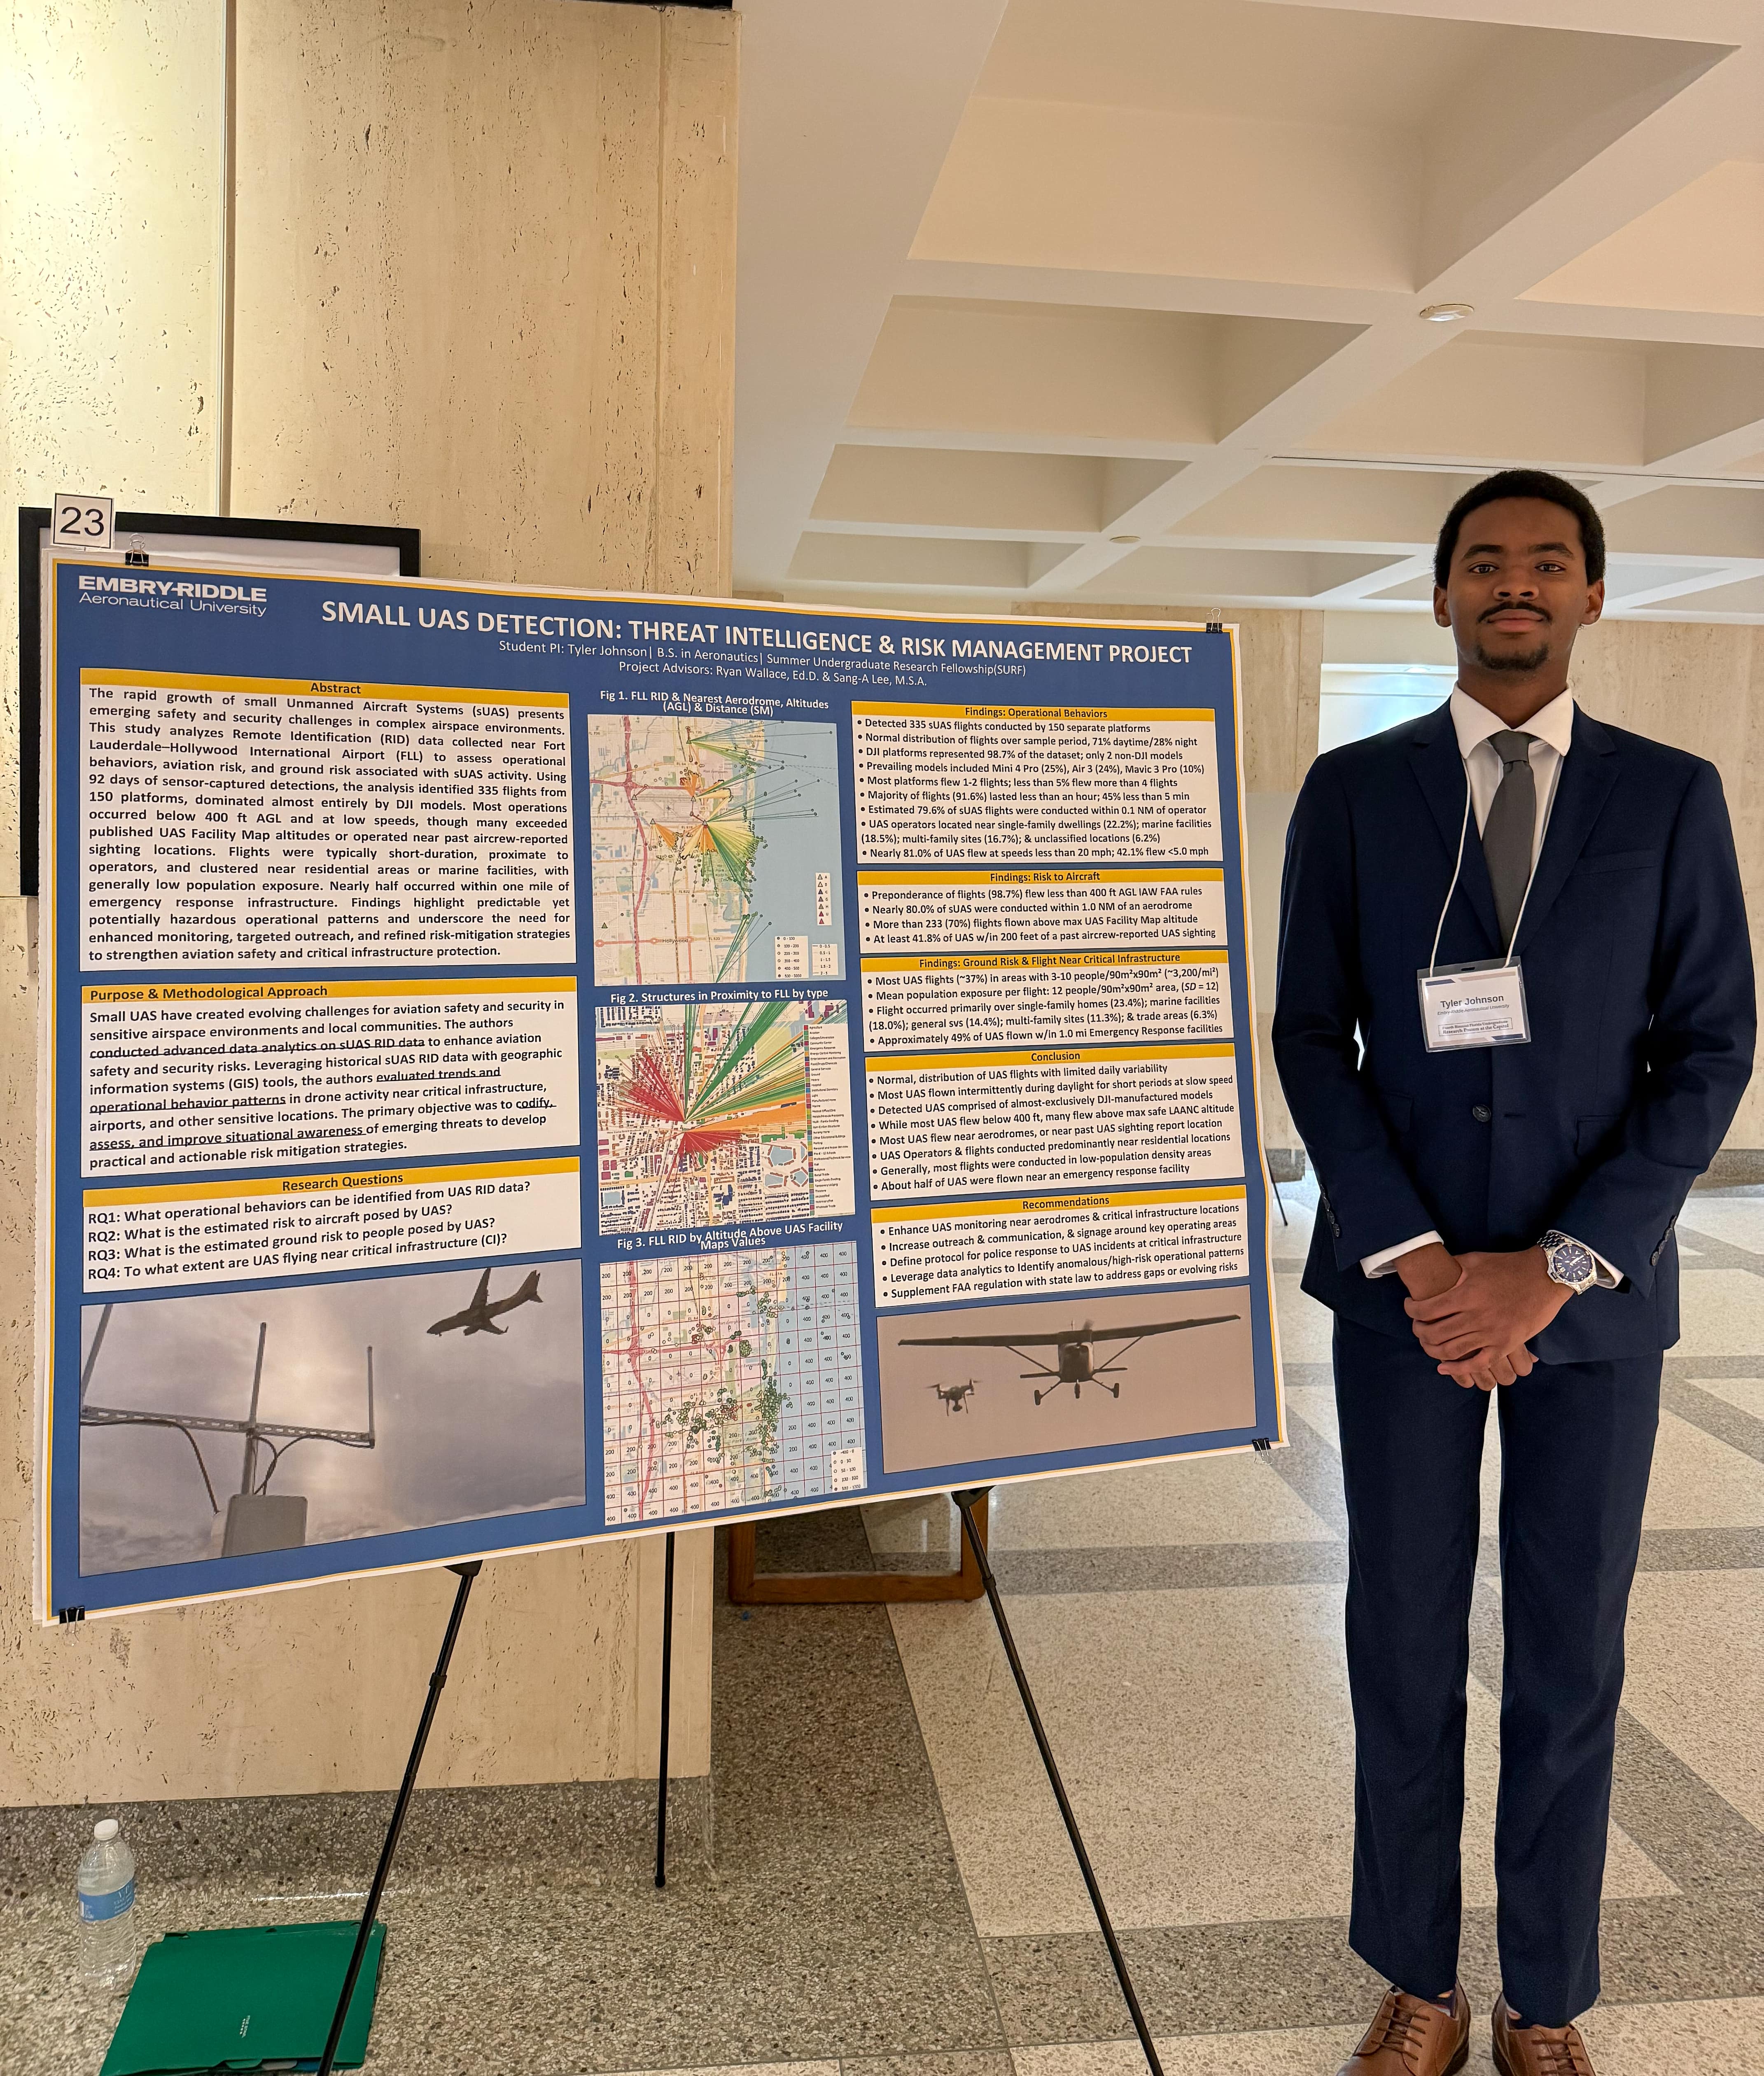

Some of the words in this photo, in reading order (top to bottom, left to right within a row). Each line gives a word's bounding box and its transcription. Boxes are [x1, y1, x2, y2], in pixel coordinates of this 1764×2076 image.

[60, 507, 104, 536] 23
[79, 575, 267, 602] EMBRY-RIDDLE
[79, 592, 183, 609] Aeronautical
[190, 599, 266, 617] University
[322, 601, 411, 626] SMALL
[419, 607, 469, 630] UAS
[478, 612, 621, 639] DETECTION:
[628, 621, 719, 643] THREAT
[726, 626, 872, 653] INTELLIGENCE
[879, 635, 895, 654] &
[902, 637, 946, 656] RISK
[952, 640, 1104, 661] MANAGEMENT
[1109, 645, 1192, 663] PROJECT
[499, 640, 546, 653] Student
[550, 643, 564, 654] PI:
[567, 644, 597, 657] Tyler
[658, 647, 677, 658] B.S.
[681, 648, 691, 659] in
[767, 654, 810, 666] Summer
[813, 657, 890, 670] Undergraduate
[894, 661, 938, 672] Research
[941, 663, 1026, 677] Fellowship(SURF)
[619, 661, 659, 674] Project
[663, 663, 713, 675] Advisors:
[716, 666, 742, 678] Ryan
[745, 667, 789, 681] Wallace,
[793, 670, 819, 681] Ed.D.
[822, 671, 831, 682] &
[833, 673, 869, 685] Sang-A
[872, 674, 892, 686] Lee,
[895, 675, 927, 686] M.S.A.
[310, 682, 362, 694] Abstract
[89, 687, 113, 698] The
[124, 690, 156, 702] rapid
[167, 693, 212, 704] growth
[222, 695, 236, 705] of
[244, 697, 276, 707] small
[287, 698, 353, 710] Unmanned
[363, 701, 408, 712] Aircraft
[416, 704, 464, 716] Systems
[473, 705, 509, 719] (sUAS)
[518, 711, 564, 720] presents
[600, 690, 616, 702] Fig
[618, 691, 628, 700] 1.
[631, 691, 648, 701] FLL
[651, 692, 669, 701] RID
[672, 692, 680, 701] &
[683, 693, 723, 703] Nearest
[725, 695, 783, 708] Aerodrome,
[786, 698, 829, 709] Altitudes
[663, 701, 691, 713] (AGL)
[694, 703, 703, 712] &
[705, 703, 747, 714] Distance
[751, 705, 773, 717] (SM)
[965, 707, 1006, 718] Findings:
[1008, 708, 1062, 719] Operational
[1064, 709, 1108, 718] Behaviors
[990, 873, 1031, 883] Findings:
[1033, 872, 1052, 881] Risk
[1066, 871, 1101, 881] Aircraft
[919, 958, 961, 969] Findings:
[963, 957, 998, 967] Ground
[1000, 957, 1019, 966] Risk
[1022, 957, 1029, 965] &
[1031, 956, 1057, 967] Flight
[1084, 955, 1115, 964] Critical
[1118, 954, 1181, 963] Infrastructure
[91, 990, 144, 1003] Purpose
[148, 988, 159, 1002] &
[163, 986, 264, 1001] Methodological
[266, 985, 327, 999] Approach
[611, 993, 626, 1005] Fig
[629, 993, 638, 1002] 2.
[642, 993, 695, 1002] Structures
[698, 991, 708, 1000] in
[711, 990, 759, 1001] Proximity
[761, 990, 772, 999] to
[775, 989, 790, 998] FLL
[792, 988, 804, 1000] by
[807, 989, 828, 999] type
[1440, 999, 1462, 1009] Tyler
[1464, 995, 1504, 1005] Johnson
[90, 1011, 125, 1023] Small
[130, 1011, 157, 1021] UAS
[161, 1010, 192, 1020] have
[196, 1008, 244, 1020] created
[248, 1007, 301, 1020] evolving
[305, 1006, 369, 1018] challenges
[372, 1004, 390, 1015] for
[394, 1004, 441, 1014] aviation
[444, 1002, 480, 1014] safety
[483, 1001, 504, 1011] and
[507, 1000, 551, 1012] security
[554, 1000, 564, 1009] in
[1031, 1051, 1080, 1061] Conclusion
[877, 1074, 916, 1085] Normal,
[919, 1072, 974, 1083] distribution
[977, 1071, 986, 1080] of
[989, 1070, 1008, 1079] UAS
[1010, 1069, 1038, 1080] flights
[1041, 1067, 1061, 1077] with
[1064, 1066, 1096, 1077] limited
[1099, 1065, 1120, 1076] daily
[1122, 1064, 1167, 1074] variability
[282, 1177, 338, 1192] Research
[342, 1174, 404, 1188] Questions
[1022, 1196, 1109, 1210] Recommendations
[889, 1225, 929, 1235] Enhance
[932, 1222, 952, 1232] UAS
[954, 1219, 1007, 1231] monitoring
[1010, 1219, 1031, 1227] near
[1034, 1214, 1090, 1225] aerodromes
[1092, 1212, 1100, 1221] &
[1102, 1210, 1133, 1220] critical
[1135, 1207, 1197, 1218] infrastructure
[1200, 1204, 1239, 1214] locations
[617, 1238, 633, 1250] Fig
[635, 1237, 645, 1247] 3.
[649, 1235, 666, 1246] FLL
[668, 1234, 686, 1244] RID
[690, 1232, 702, 1244] by
[705, 1228, 748, 1240] Altitude
[749, 1226, 782, 1237] Above
[785, 1224, 805, 1234] UAS
[808, 1221, 843, 1232] Facility
[701, 1240, 729, 1251] Maps
[732, 1237, 766, 1247] Values
[89, 1268, 120, 1280] RQ4:
[124, 1266, 141, 1277] To
[145, 1263, 179, 1275] what
[182, 1259, 225, 1272] extent
[228, 1259, 249, 1268] are
[253, 1254, 279, 1266] UAS
[282, 1252, 317, 1265] flying
[321, 1250, 349, 1260] near
[352, 1243, 392, 1257] critical
[396, 1238, 478, 1253] infrastructure
[481, 1233, 507, 1247] (CI)?
